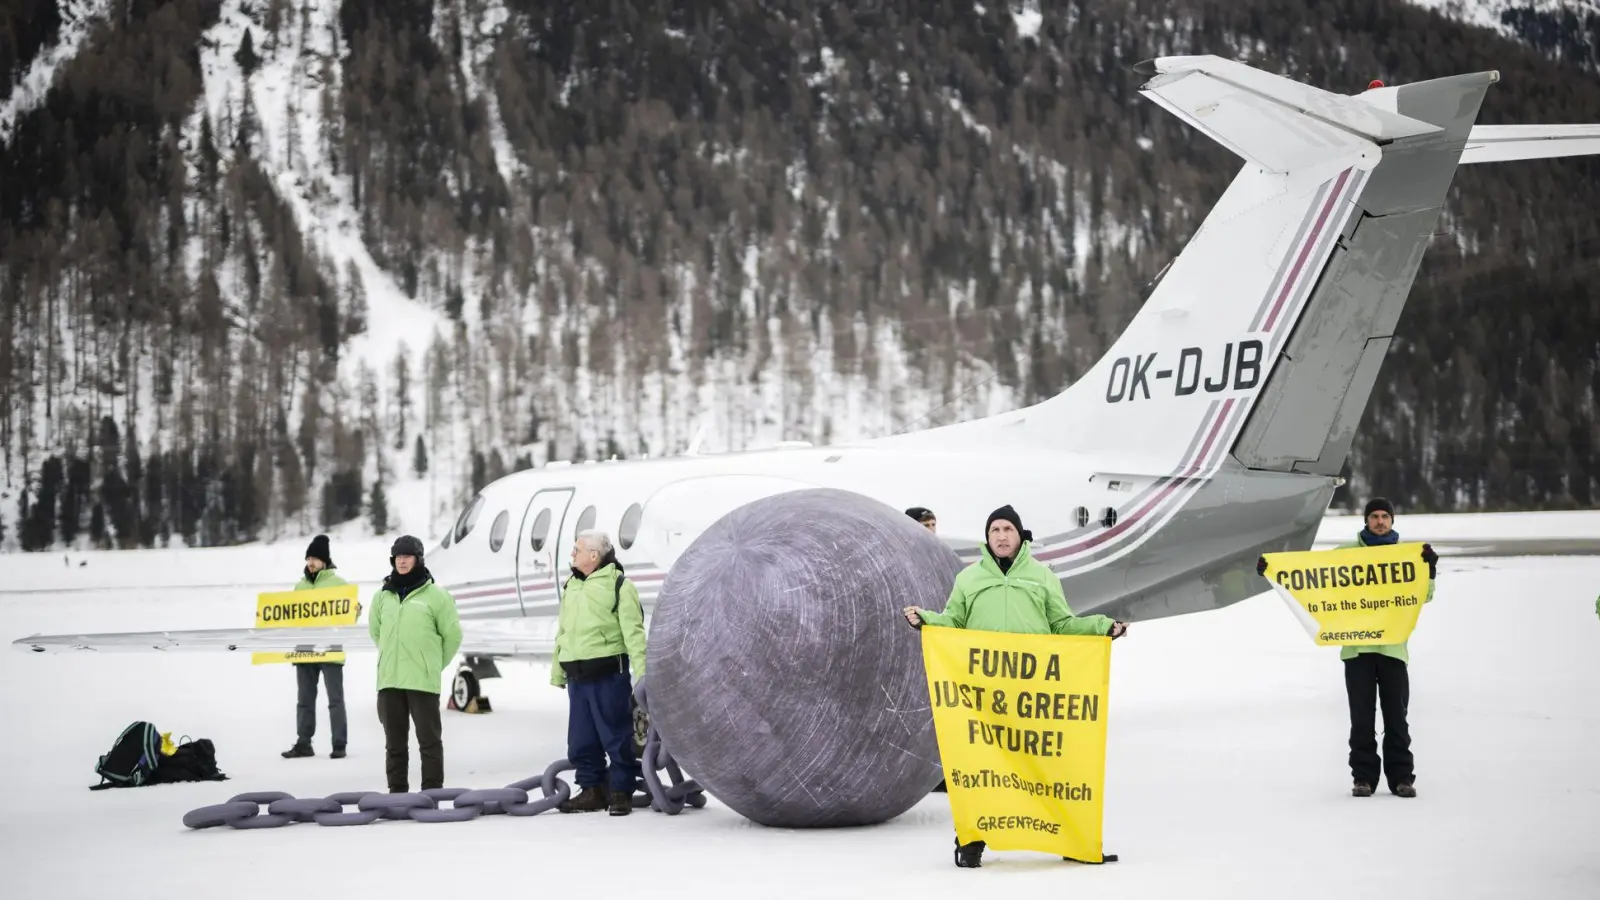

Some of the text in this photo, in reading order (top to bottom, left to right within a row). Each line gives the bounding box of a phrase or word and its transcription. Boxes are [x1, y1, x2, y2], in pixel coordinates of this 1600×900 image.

[1106, 339, 1264, 404] OK-DJB
[1276, 561, 1416, 591] CONFISCATED
[262, 599, 351, 622] CONFISCATED
[1308, 595, 1418, 613] to Tax the Super-Rich
[1320, 630, 1385, 641] GREENPEACE
[968, 647, 1061, 682] FUND A
[934, 681, 1099, 721] JUST & GREEN
[968, 719, 1064, 757] FUTURE!
[976, 816, 1062, 835] GREENPEACE
